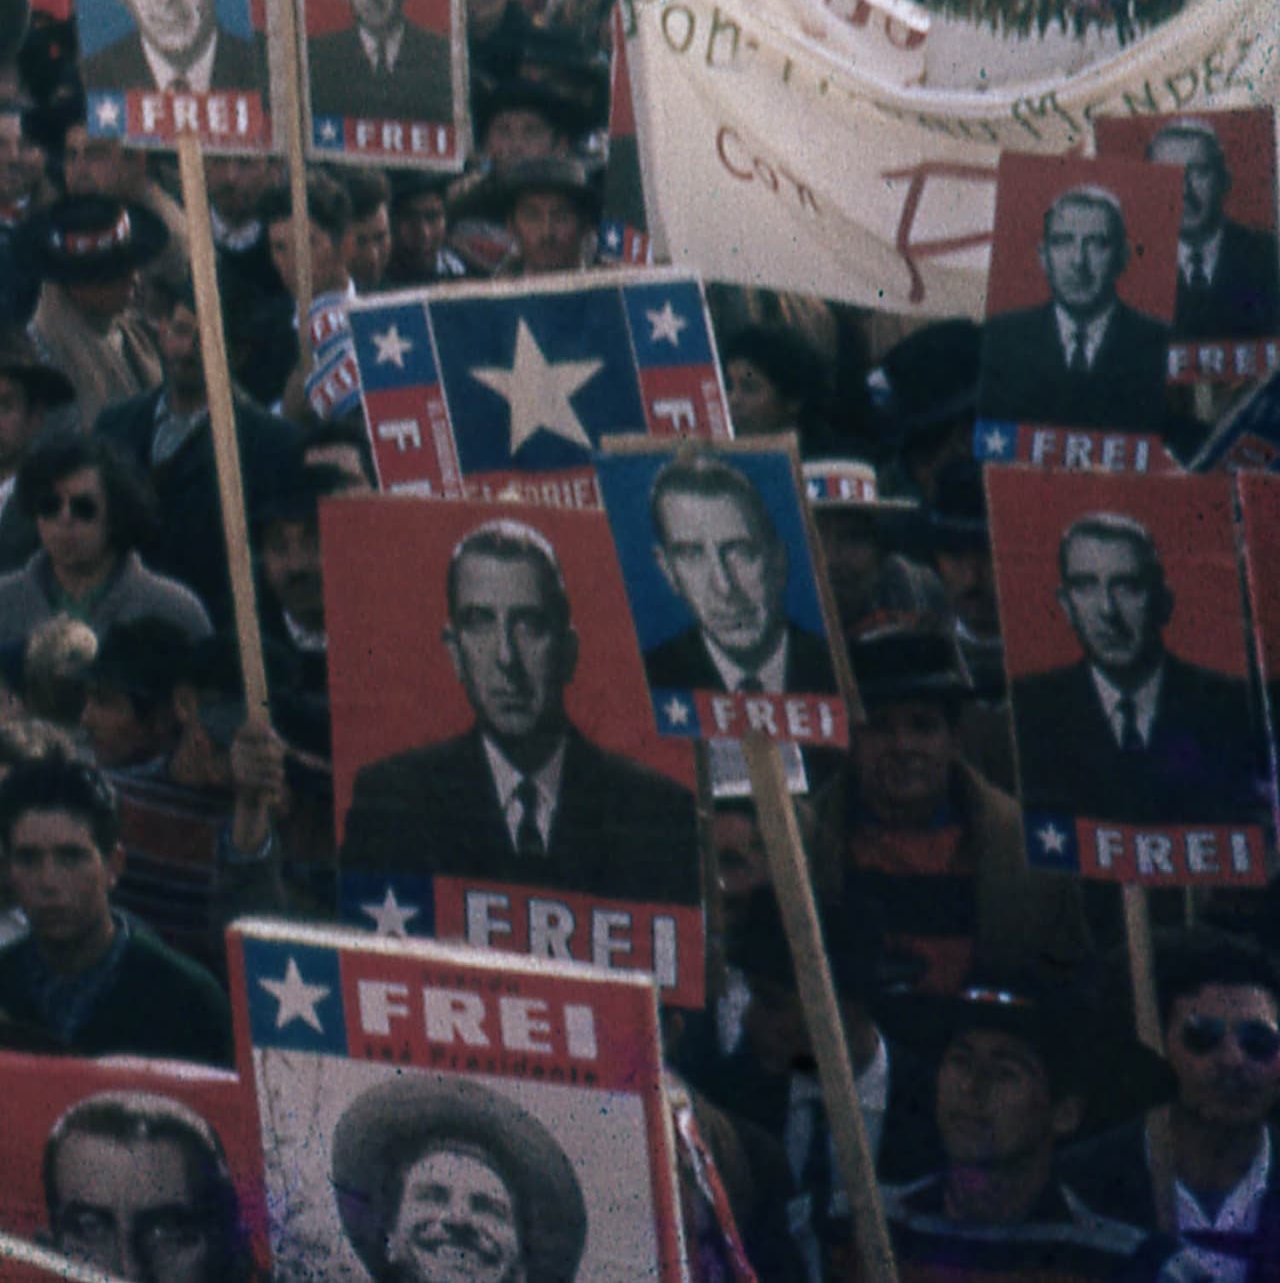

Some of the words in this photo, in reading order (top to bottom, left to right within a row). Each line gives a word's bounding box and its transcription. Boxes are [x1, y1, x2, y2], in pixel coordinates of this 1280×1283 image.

[140, 94, 251, 135] FREI
[354, 120, 450, 155] FREI
[1032, 429, 1152, 473] FREI
[711, 694, 836, 741] FREI
[1096, 828, 1250, 875] FREI
[462, 889, 681, 989] FREI
[356, 977, 599, 1060] FREI
